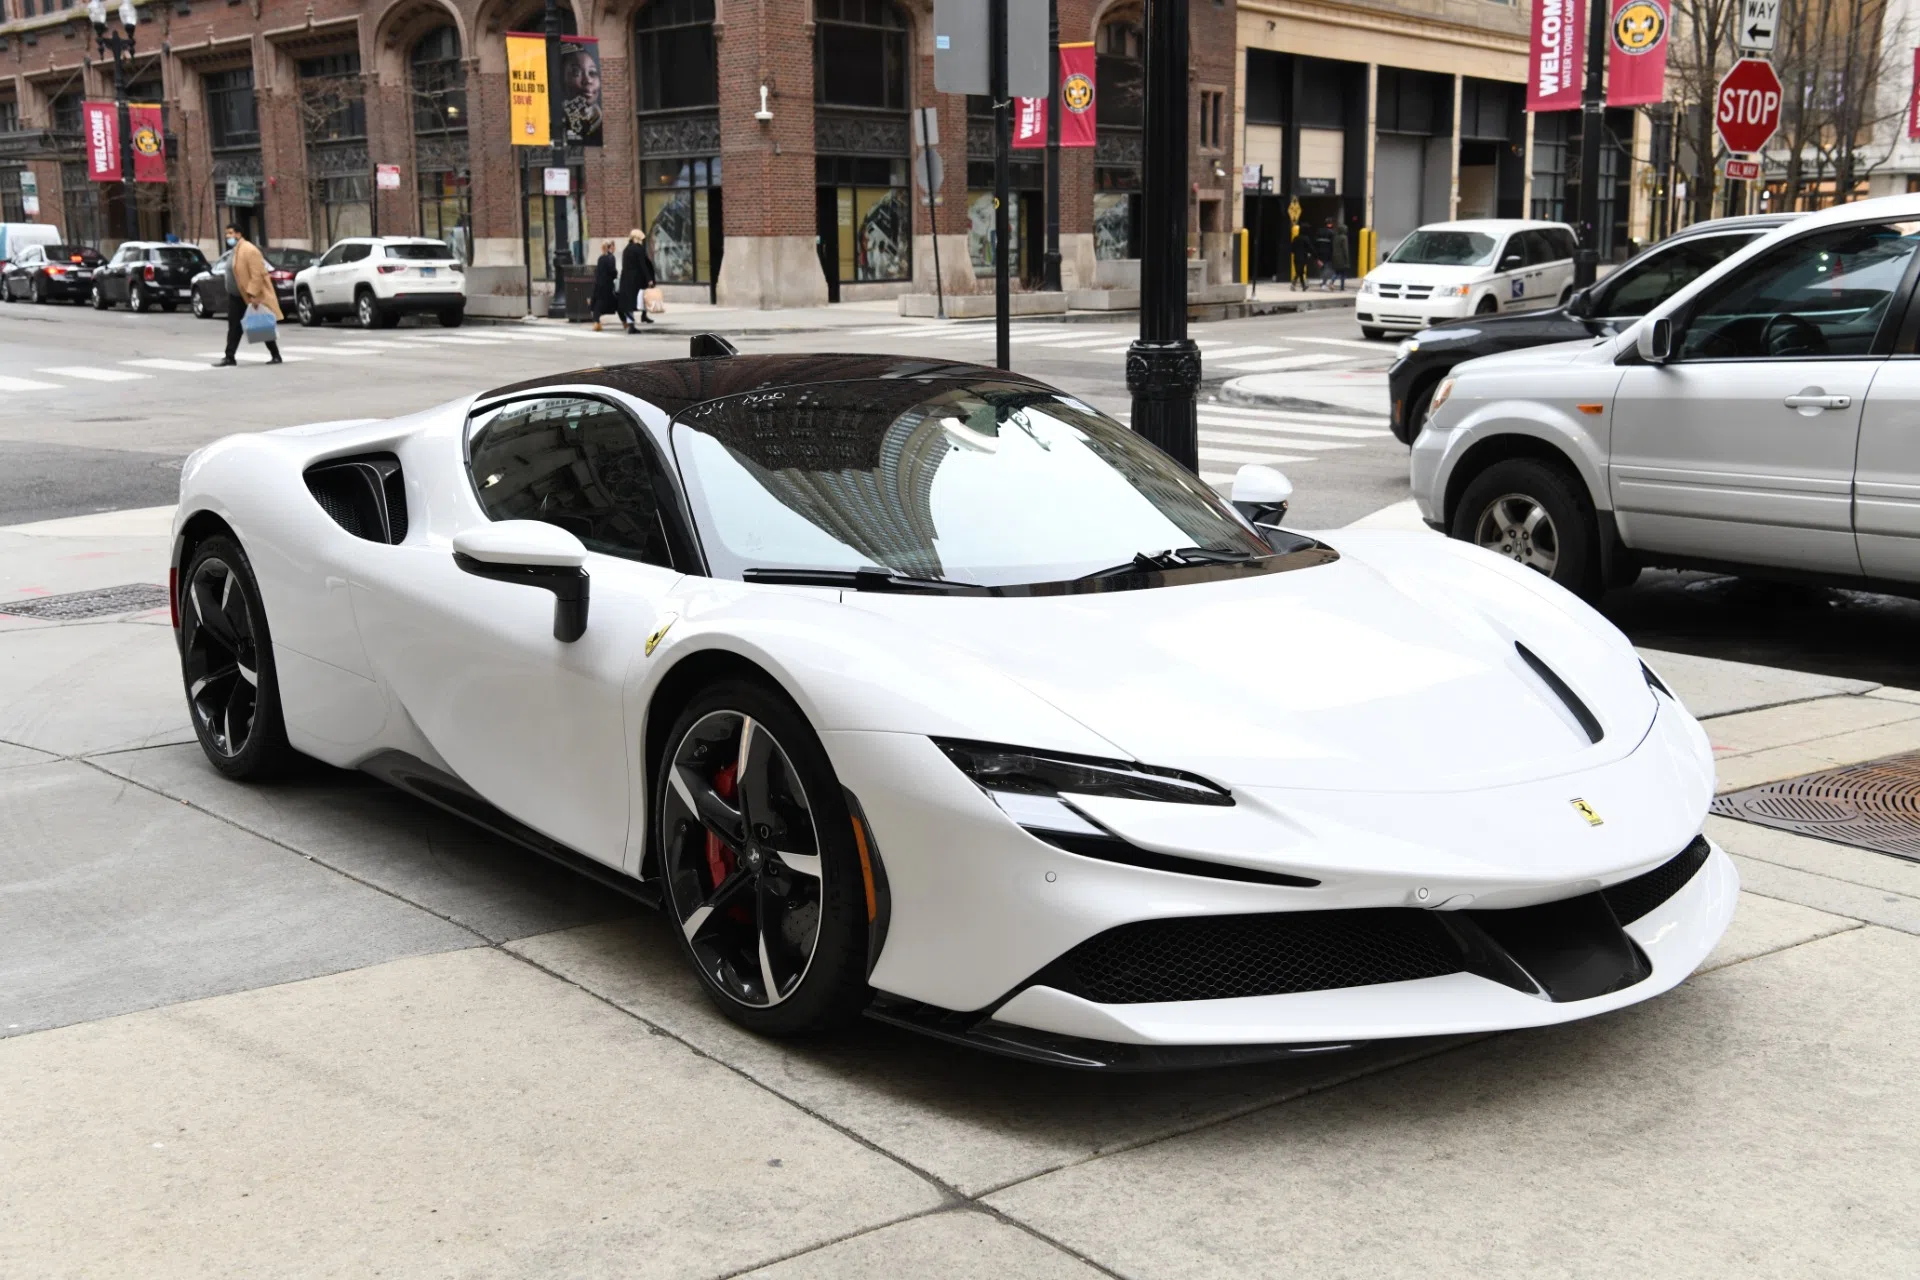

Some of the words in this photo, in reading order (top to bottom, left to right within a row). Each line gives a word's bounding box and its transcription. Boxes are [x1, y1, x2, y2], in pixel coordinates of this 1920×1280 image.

[1566, 0, 1575, 23] CAMP
[1748, 1, 1776, 20] WAY
[1539, 0, 1562, 97] WELCOM
[1563, 25, 1573, 56] TOWER
[512, 70, 522, 81] WE
[523, 70, 536, 81] ARE
[512, 82, 536, 93] CALLED
[537, 83, 545, 93] TO
[1562, 58, 1571, 89] WATER
[1020, 97, 1035, 139] WELC
[1719, 87, 1778, 125] STOP
[90, 110, 108, 173] WELCOME
[1728, 162, 1741, 176] ALL
[1742, 163, 1757, 177] WAY
